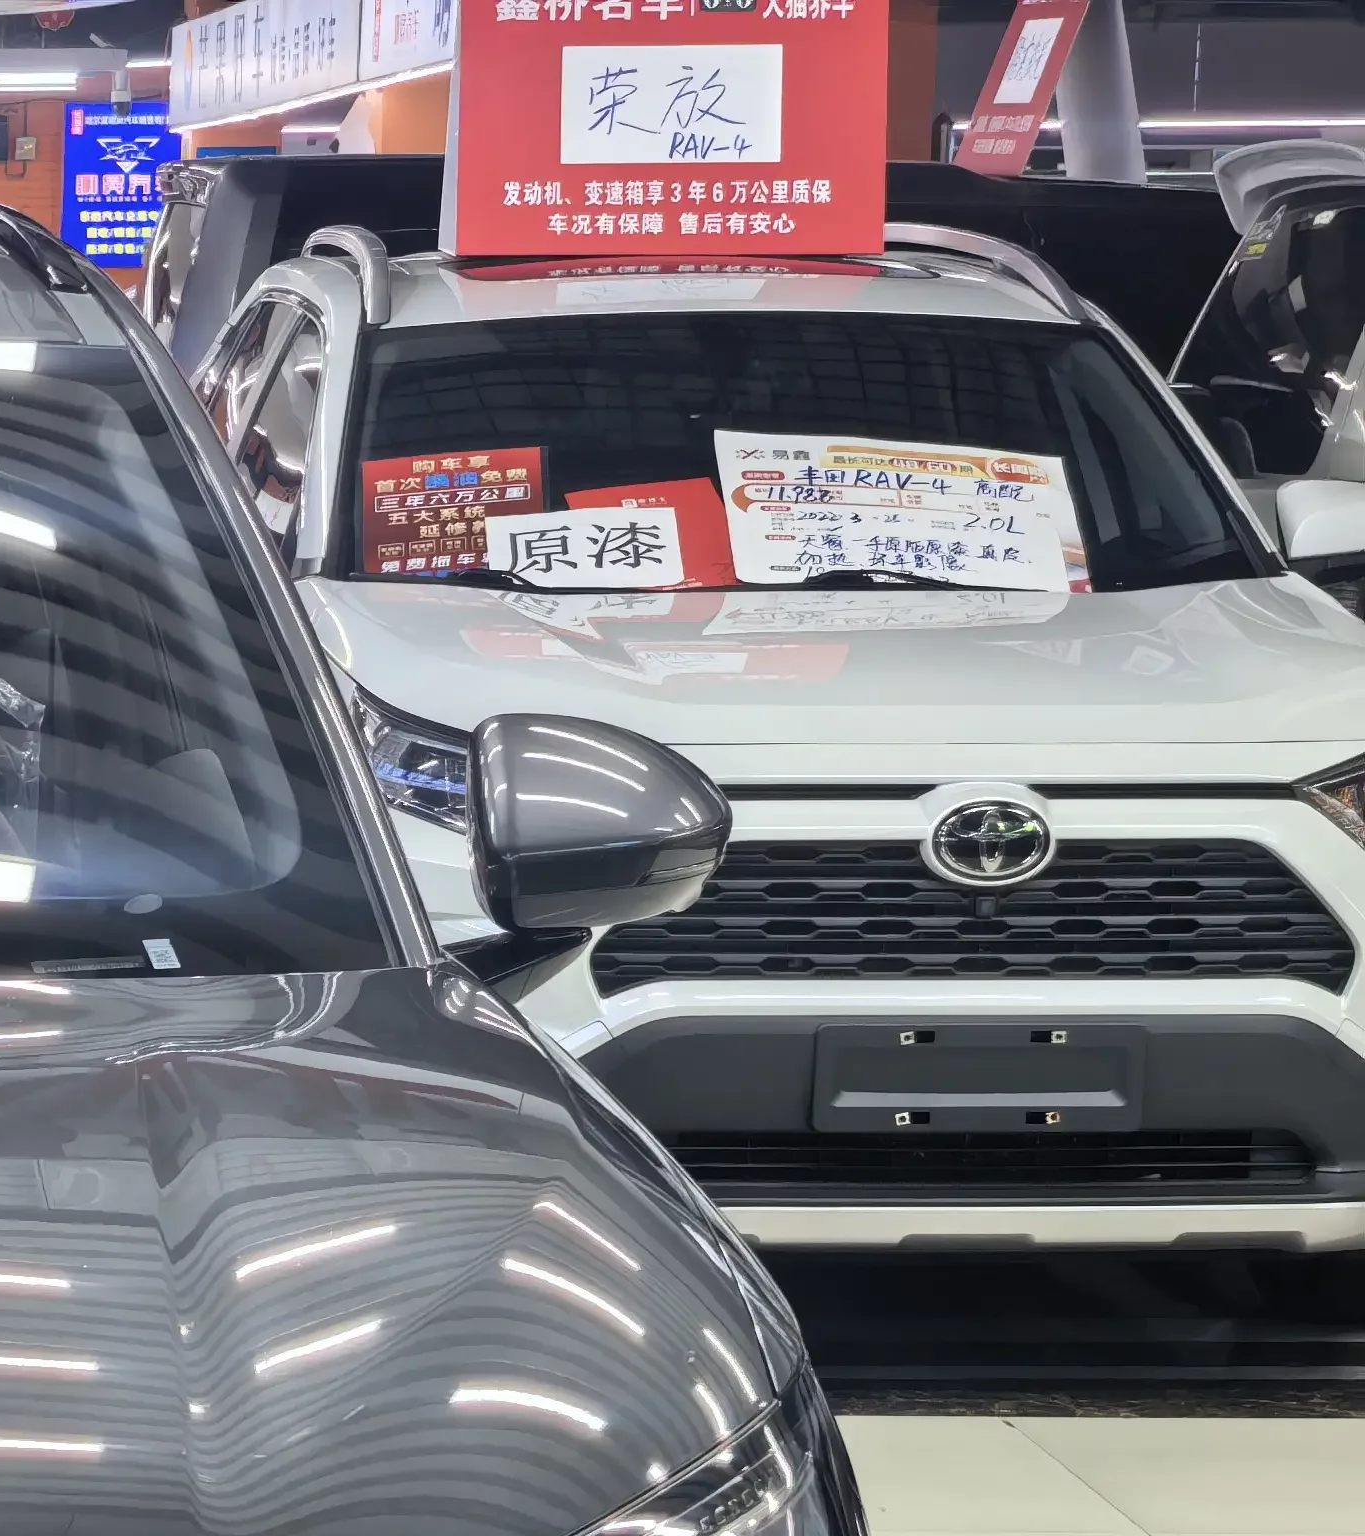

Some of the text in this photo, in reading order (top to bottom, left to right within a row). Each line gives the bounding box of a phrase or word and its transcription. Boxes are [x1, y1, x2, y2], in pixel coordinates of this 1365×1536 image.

[588, 66, 746, 136] 荣放
[669, 133, 753, 160] RAV-4
[548, 213, 796, 235] 车况有保障 售后有安心
[412, 455, 491, 474] 购车享
[794, 465, 846, 486] 丰田
[854, 469, 953, 495] RAV-4
[379, 486, 526, 509] 三年六万公里
[963, 512, 1026, 535] 2.0L
[509, 522, 667, 573] 原漆
